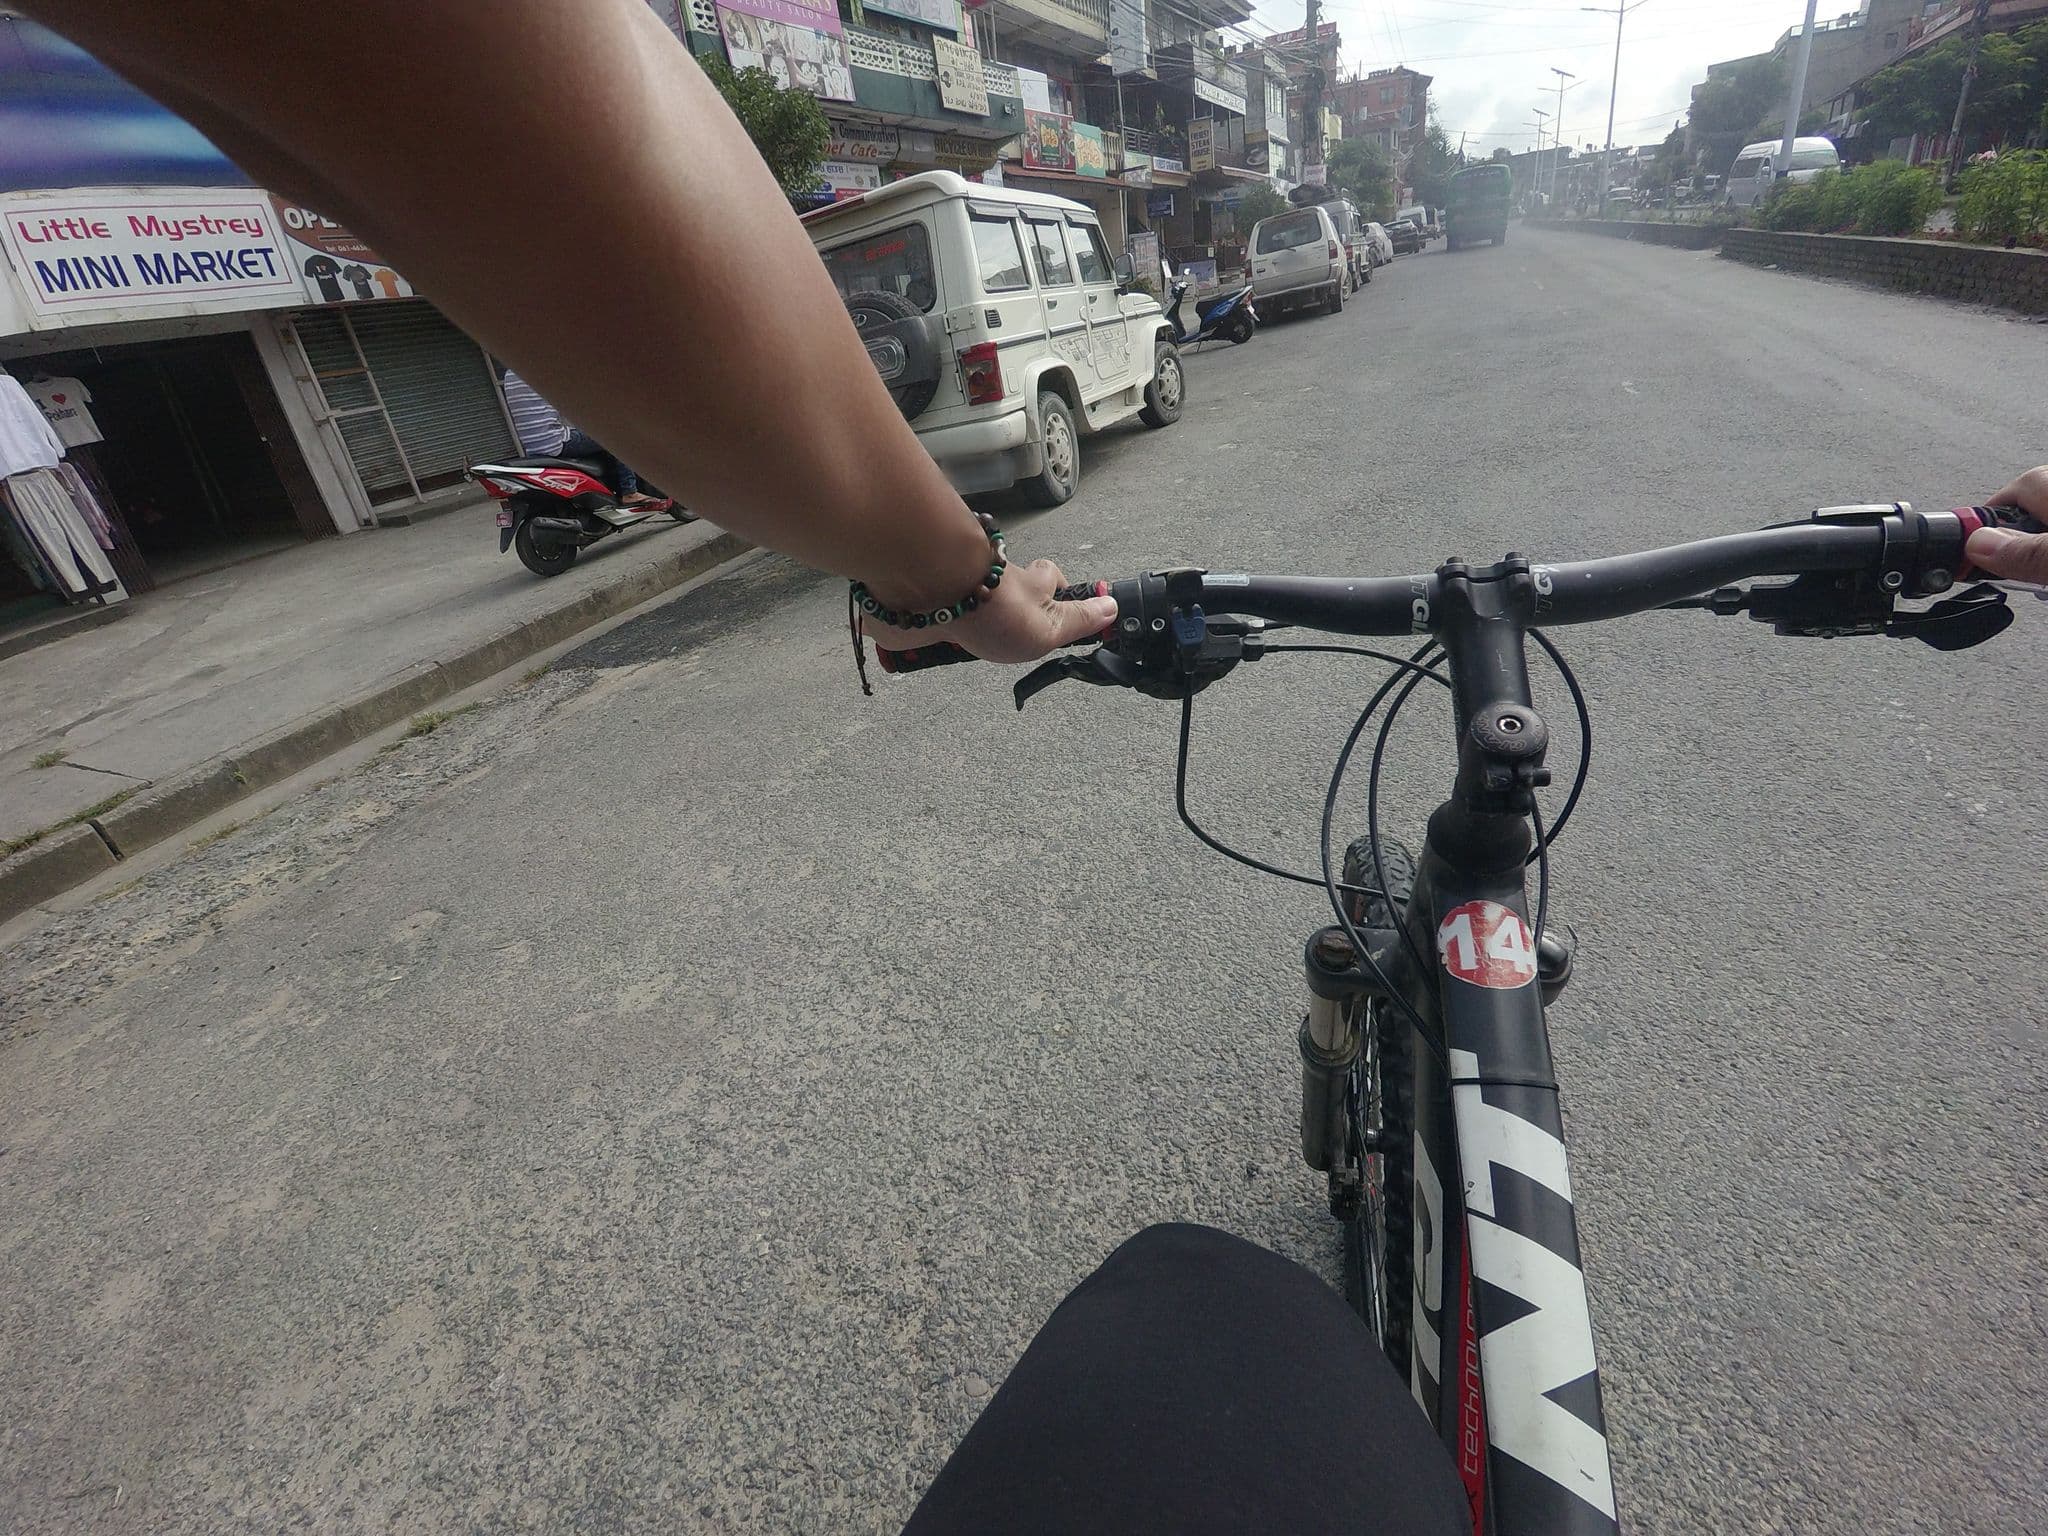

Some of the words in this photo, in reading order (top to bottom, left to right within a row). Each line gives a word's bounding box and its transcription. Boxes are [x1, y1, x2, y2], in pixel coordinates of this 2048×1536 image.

[839, 122, 897, 143] Communication
[851, 143, 877, 157] Cafe
[17, 218, 112, 244] Little
[127, 214, 263, 241] Mystrey
[34, 254, 131, 293] MINI
[133, 248, 279, 286] MARKET
[1440, 913, 1536, 974] 14
